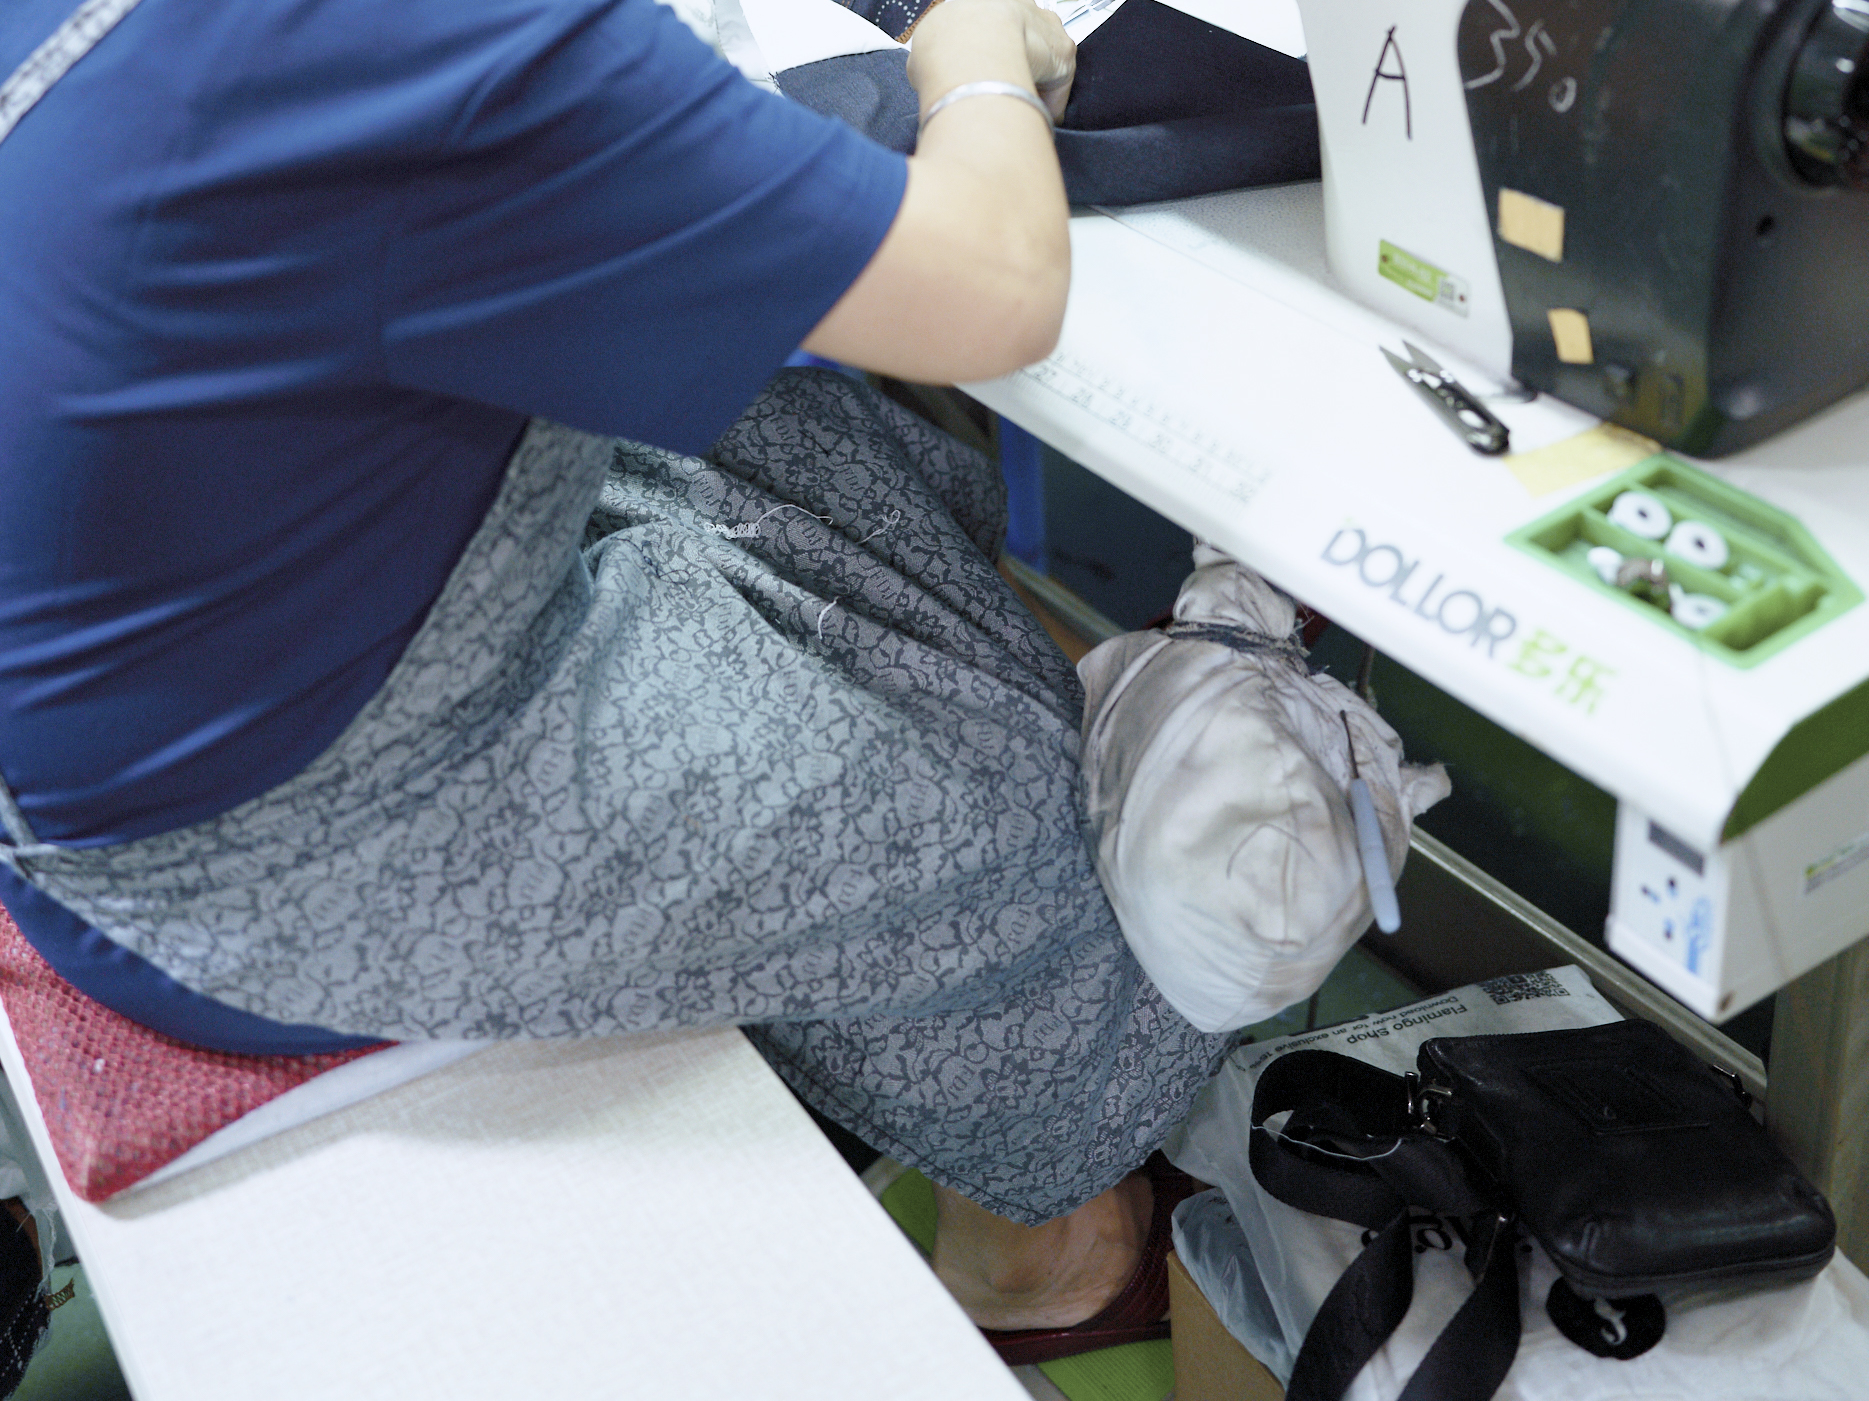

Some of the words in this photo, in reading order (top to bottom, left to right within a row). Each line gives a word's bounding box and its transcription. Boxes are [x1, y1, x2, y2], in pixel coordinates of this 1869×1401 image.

[1362, 25, 1412, 141] A
[1321, 528, 1517, 658] DOLLOR
[1393, 1003, 1468, 1030] Flamingo
[1398, 996, 1459, 1018] Download
[1351, 1019, 1369, 1033] for
[1372, 1012, 1397, 1027] now
[1275, 1031, 1330, 1053] exclusive
[1331, 1027, 1348, 1038] an
[1346, 1025, 1390, 1045] Shop
